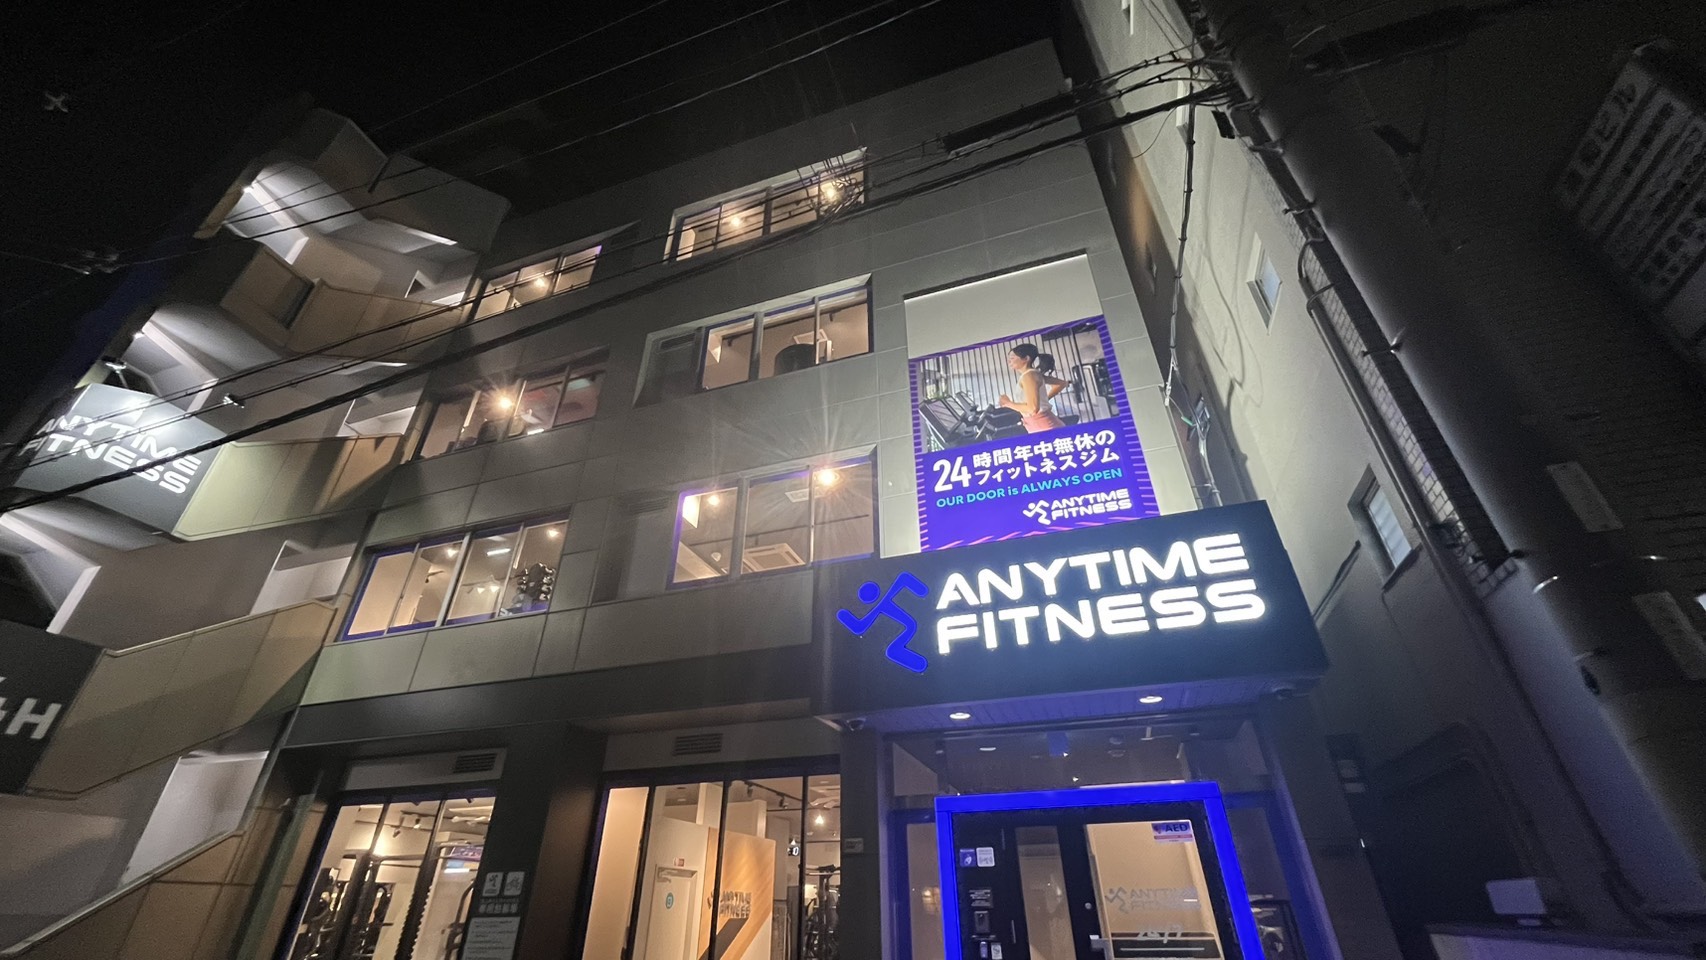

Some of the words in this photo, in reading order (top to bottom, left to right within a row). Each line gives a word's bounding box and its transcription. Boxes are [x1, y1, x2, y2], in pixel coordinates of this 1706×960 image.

[18, 433, 191, 494] FITNESS
[35, 415, 202, 476] ANYTIME
[973, 429, 1116, 468] 時間年中無休の
[933, 455, 972, 493] 24
[975, 447, 1120, 486] フィットネスジム
[936, 494, 964, 508] OUR
[966, 487, 1006, 502] DOOR
[1007, 485, 1019, 496] is
[1021, 474, 1081, 494] ALWAYS
[1084, 467, 1123, 484] OPEN
[1051, 488, 1130, 511] ANYTIME
[1051, 498, 1133, 521] FITNESS
[936, 532, 1252, 611] ANYTIME
[938, 578, 1267, 656] FITNESS
[1165, 823, 1189, 833] AED
